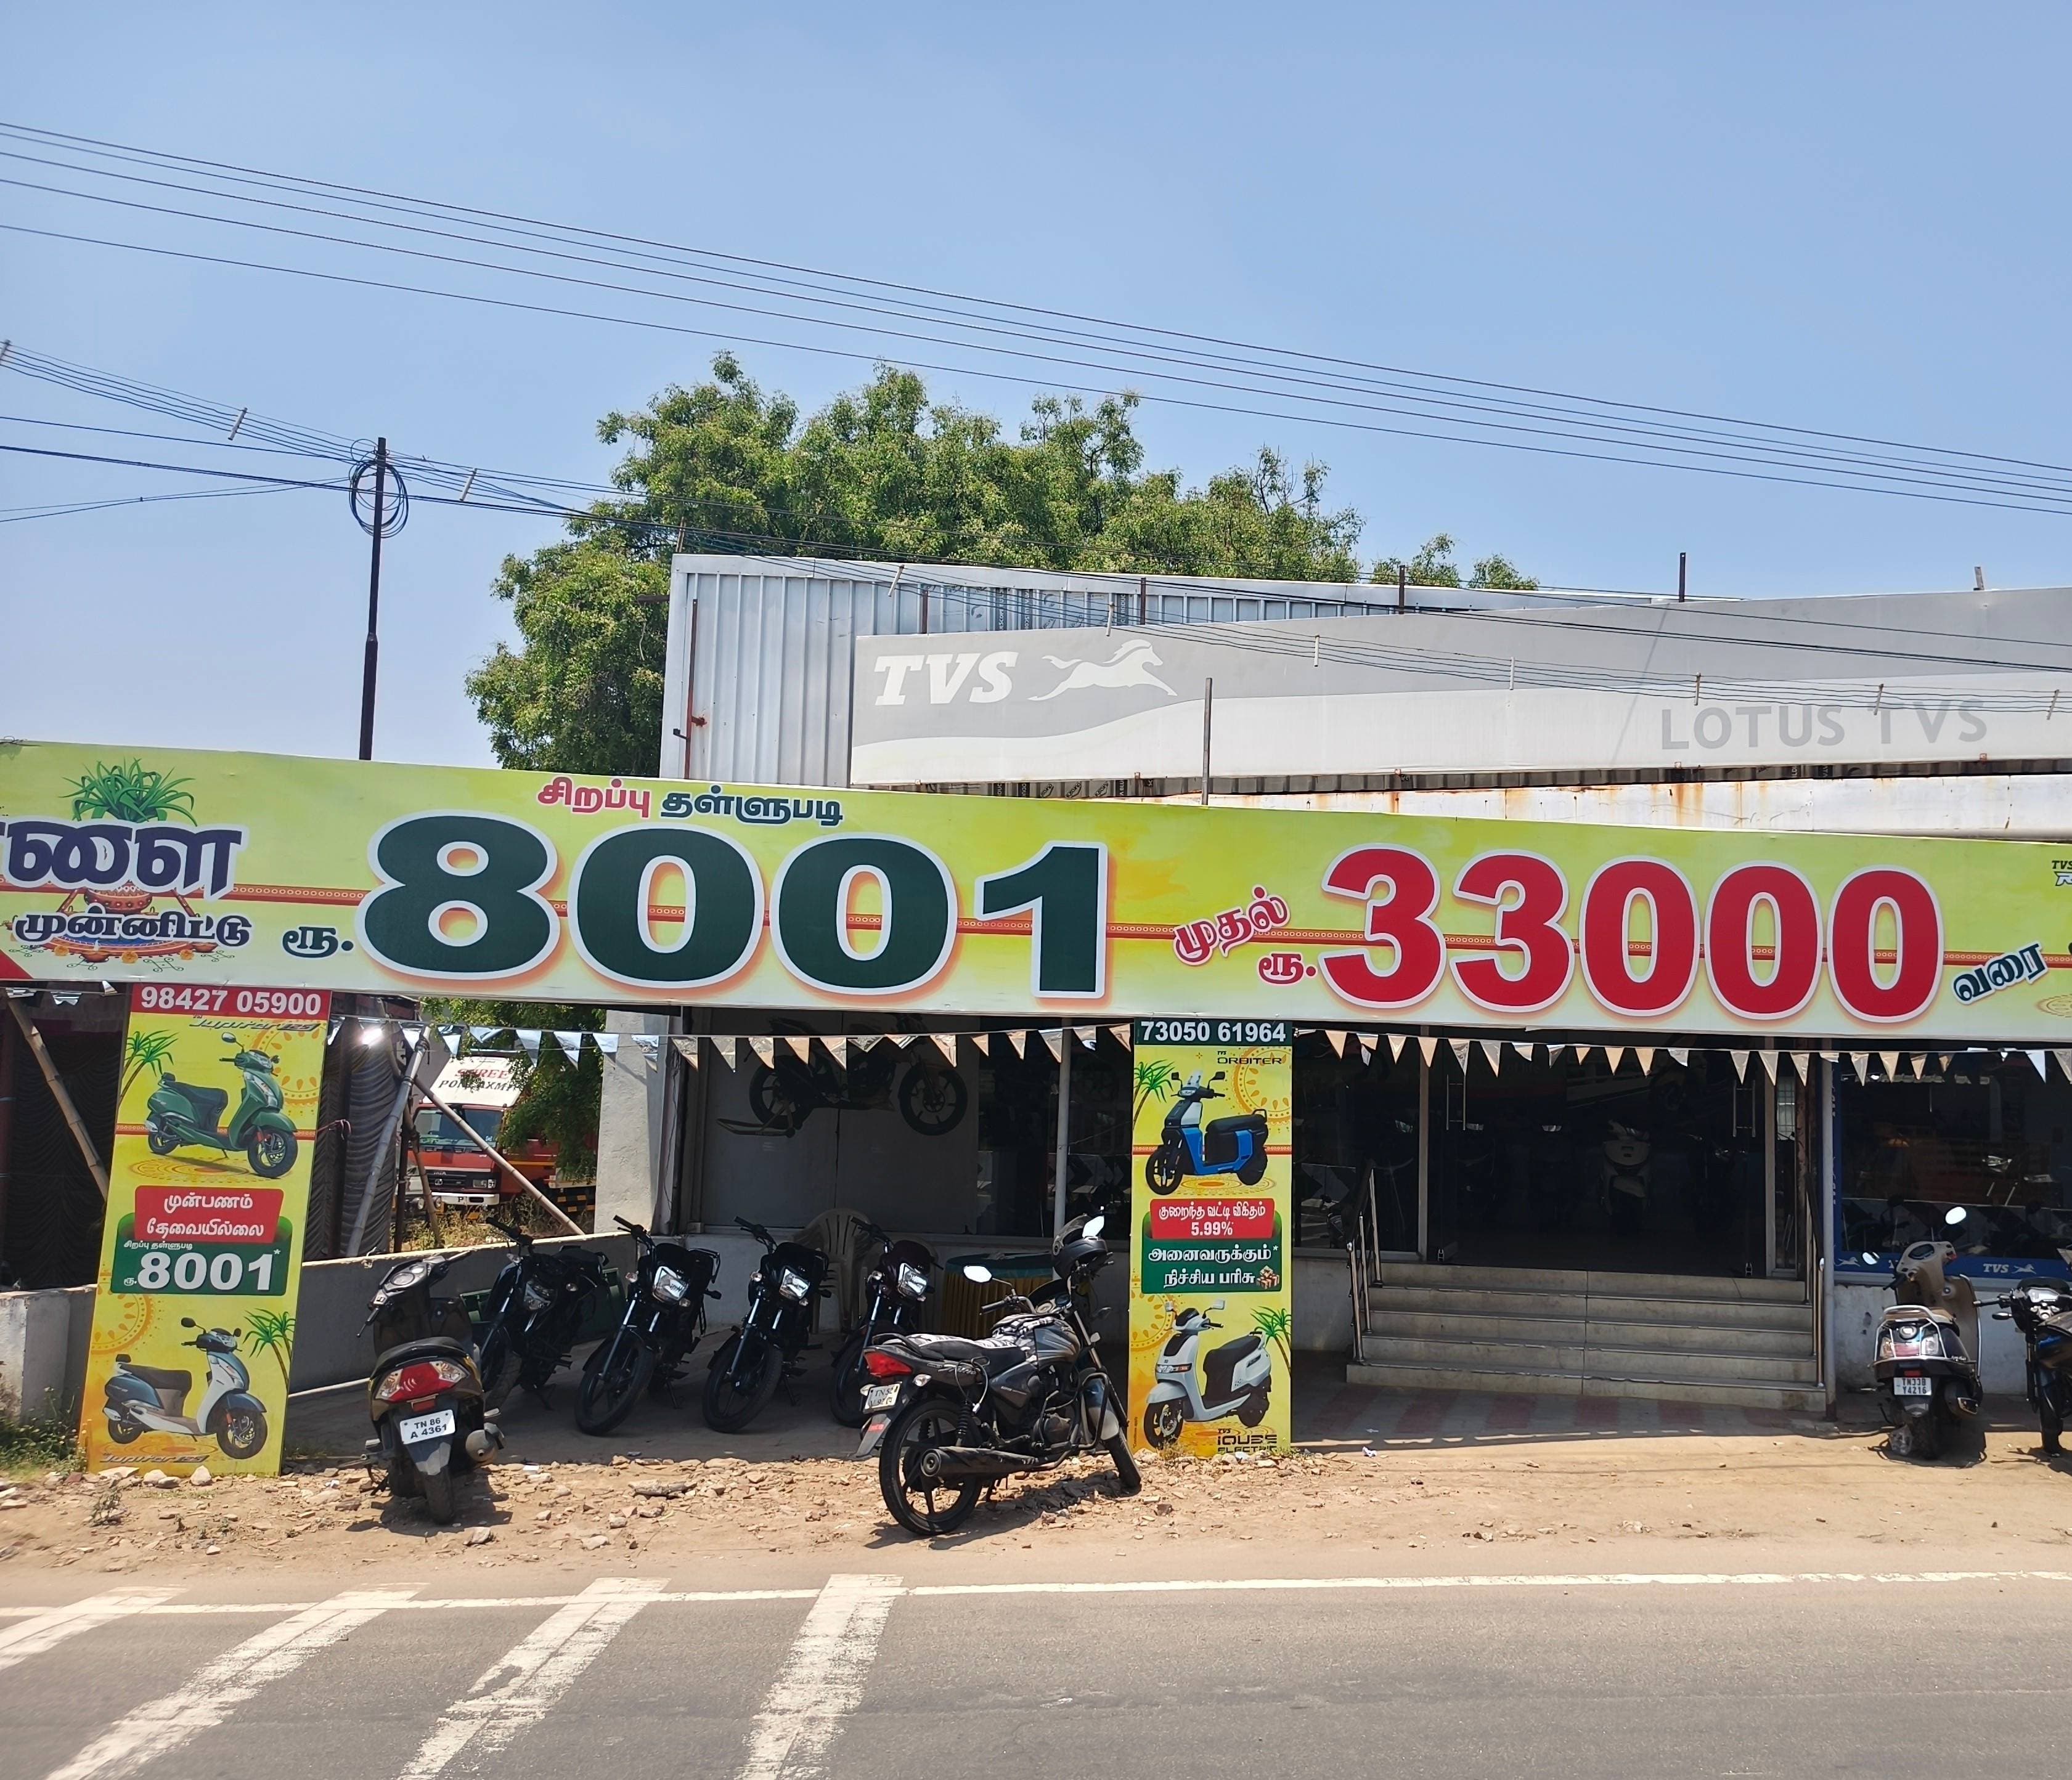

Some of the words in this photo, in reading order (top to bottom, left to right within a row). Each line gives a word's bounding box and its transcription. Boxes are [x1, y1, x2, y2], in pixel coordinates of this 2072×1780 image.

[874, 651, 1019, 706] TVS
[1662, 704, 1846, 750] LOTUS
[1867, 699, 1988, 745] TVS
[537, 776, 650, 818] சிறப்பு
[661, 784, 843, 826] தள்ளுபடி
[0, 821, 242, 896] ளை
[282, 925, 354, 958] ரூ.
[364, 815, 1100, 992] 8001
[15, 904, 252, 948] முன்னிட்டு
[1175, 887, 1288, 962] முதல்
[1258, 953, 1316, 985] ரூ.
[1318, 848, 1939, 1018] 33000
[1952, 943, 2047, 1003] வரை
[141, 986, 228, 1011] 98427
[236, 991, 322, 1015] 05900
[1141, 1021, 1210, 1041] 73050
[1217, 1022, 1286, 1042] 61964
[163, 1192, 253, 1214] முன்பணம்
[1159, 1201, 1205, 1221] குறைந்த
[1207, 1201, 1231, 1221] வட்டி
[1233, 1201, 1266, 1220] விகிதம்
[147, 1217, 264, 1239] தேவையில்லை
[123, 1240, 149, 1250] சிறப்பு
[150, 1240, 194, 1250] தள்ளுபடி
[1219, 1267, 1255, 1284] பரிசு
[1983, 1264, 2009, 1274] TVS
[410, 1431, 418, 1439] A
[422, 1424, 447, 1435] 4361
[414, 1421, 427, 1429] TN
